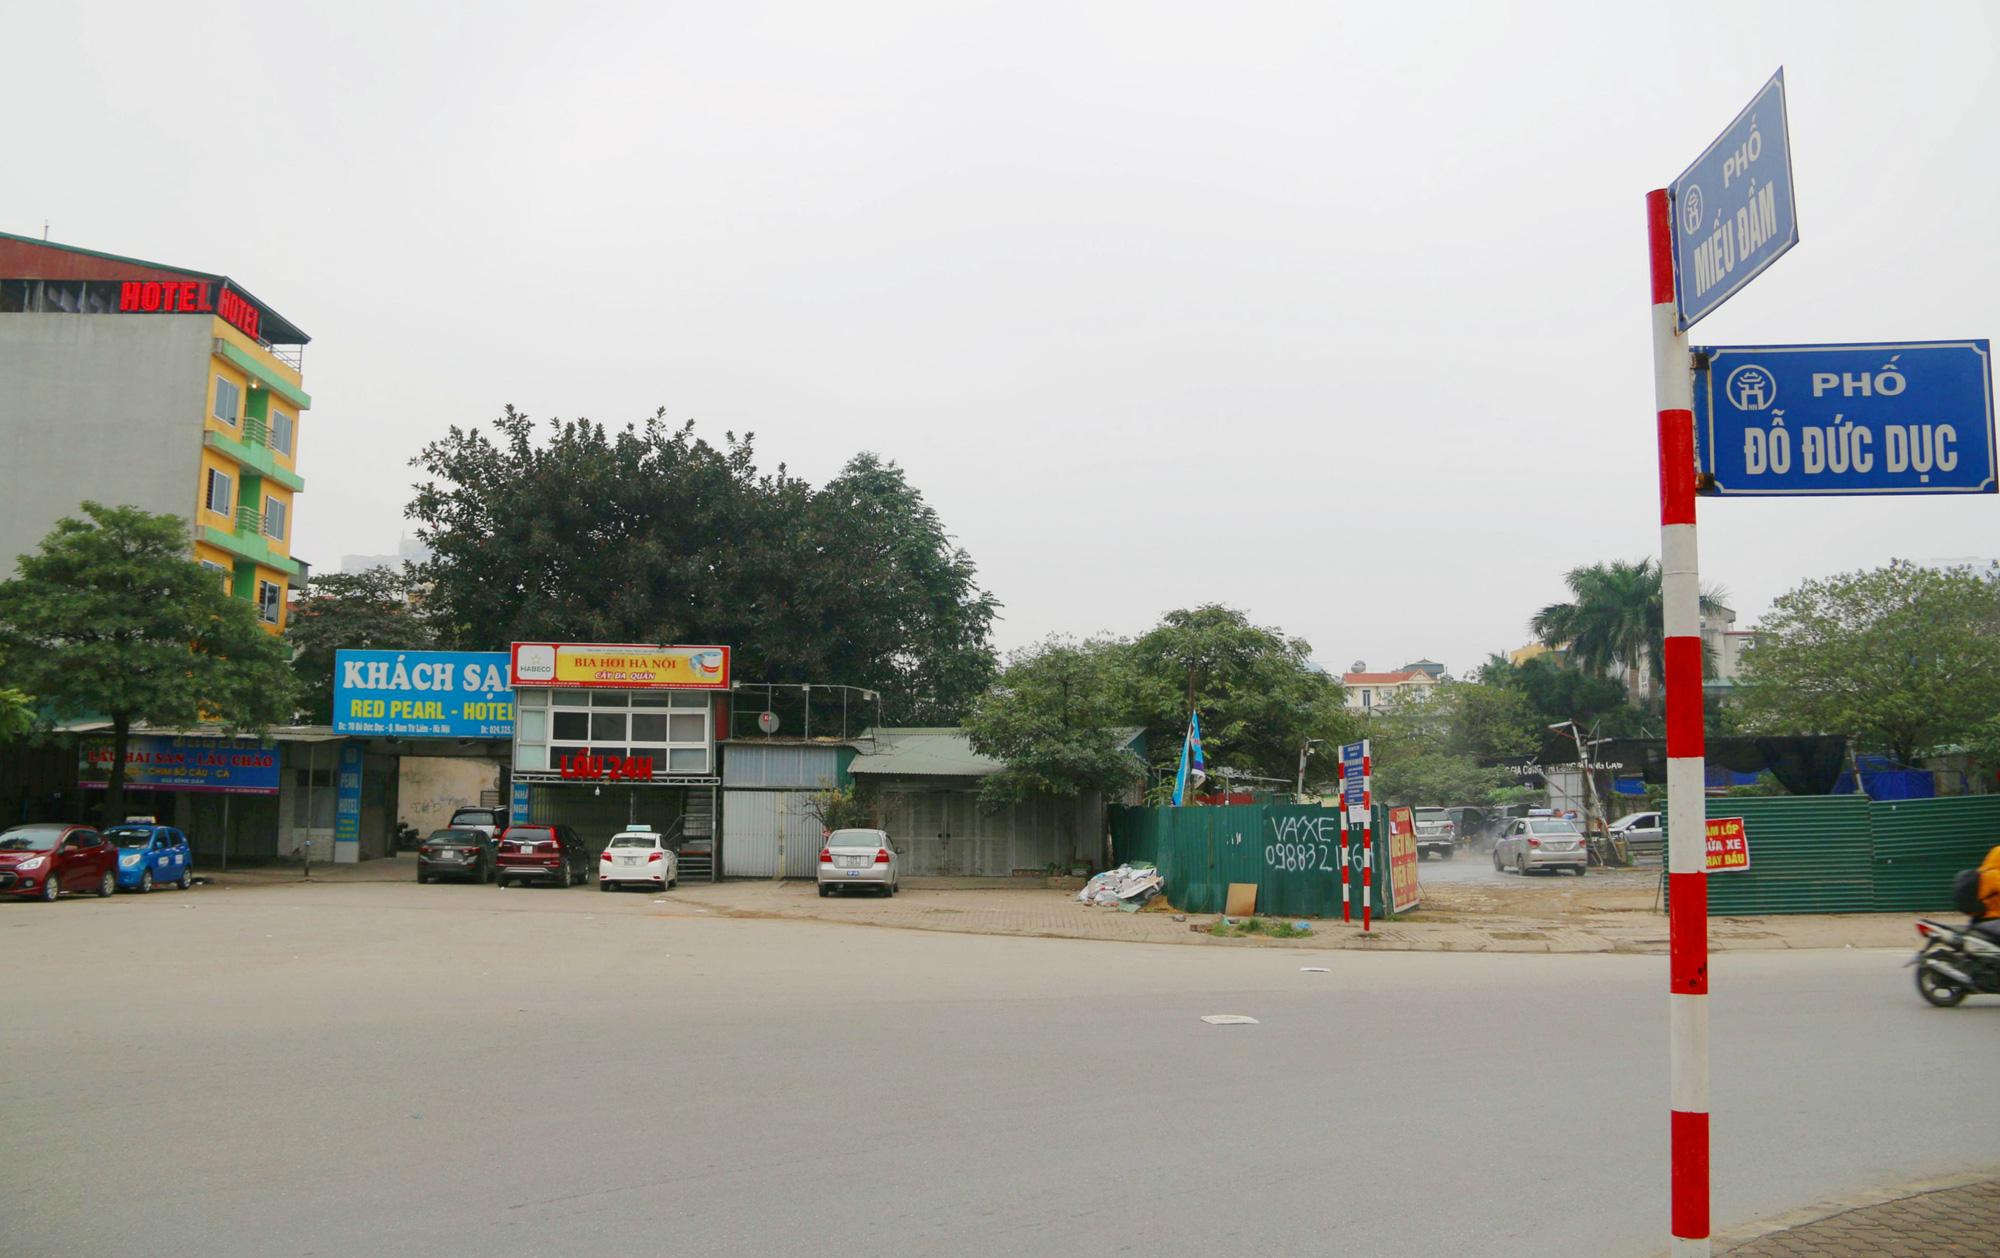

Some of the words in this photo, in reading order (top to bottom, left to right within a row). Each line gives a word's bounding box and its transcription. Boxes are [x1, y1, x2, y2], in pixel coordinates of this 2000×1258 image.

[1723, 113, 1762, 189] PHỐ
[1693, 208, 1735, 298] MIẾU
[1737, 178, 1778, 262] ĐẦM
[119, 281, 212, 311] HOTEL
[217, 287, 260, 339] HOTEL
[1812, 354, 1907, 397] PHỐ
[1744, 408, 1791, 476] ĐỖ
[1802, 414, 1874, 474] ĐỨC
[1886, 424, 1959, 483] DỤC
[343, 654, 455, 692] KHÁCH
[574, 657, 597, 668] BIA
[629, 656, 647, 669] HÀ
[651, 656, 676, 672] NỘI
[351, 699, 385, 718] RED
[390, 701, 446, 719] PEARL
[463, 702, 514, 721] HOTEL
[560, 747, 604, 779] LẨU
[608, 756, 653, 780] 24H
[338, 798, 358, 814] HOTEL
[1721, 821, 1739, 836] LỐP
[1725, 838, 1742, 850] XE
[1706, 854, 1722, 867] HAY
